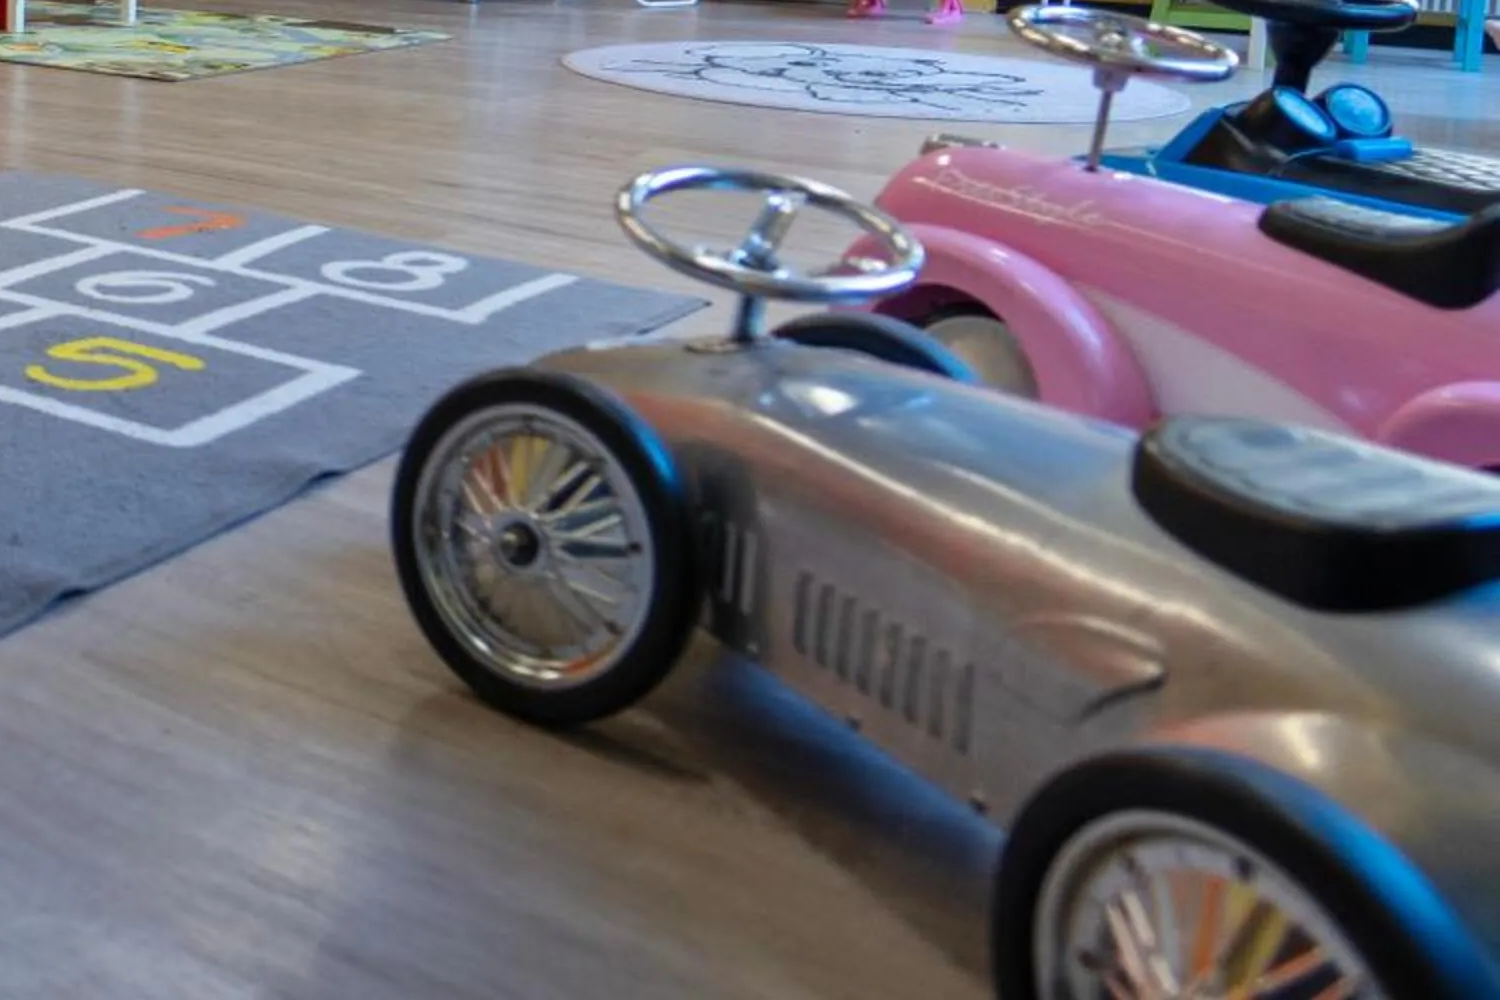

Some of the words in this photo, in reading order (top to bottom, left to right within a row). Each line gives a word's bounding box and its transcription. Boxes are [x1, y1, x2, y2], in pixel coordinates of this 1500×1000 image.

[133, 205, 247, 240] 7
[75, 270, 218, 304] 6
[320, 251, 468, 291] 8
[23, 336, 205, 391] 5
